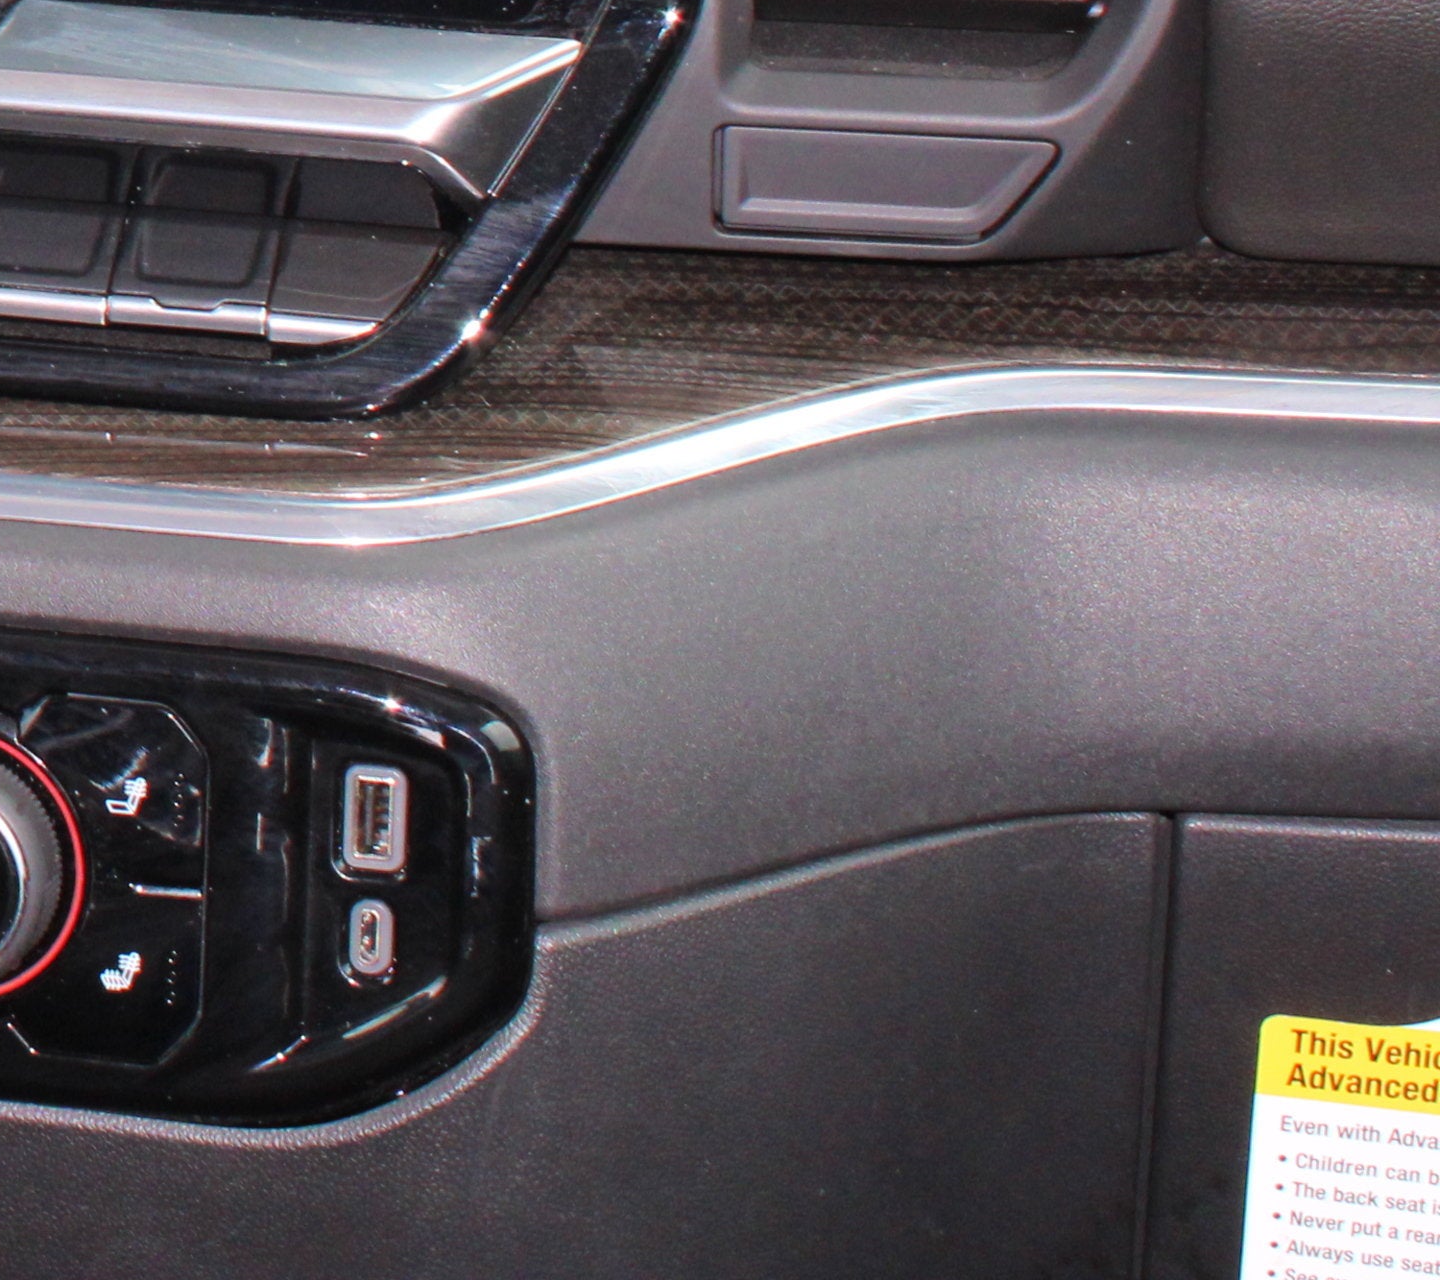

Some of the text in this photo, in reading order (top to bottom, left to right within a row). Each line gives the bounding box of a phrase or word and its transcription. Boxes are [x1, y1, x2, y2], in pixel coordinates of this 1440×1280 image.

[1291, 1028, 1354, 1059] This
[1286, 1062, 1439, 1103] Advanced
[1280, 1115, 1329, 1137] Even
[1337, 1123, 1381, 1142] with
[1295, 1152, 1378, 1177] Children
[1385, 1166, 1421, 1183] can
[1293, 1181, 1327, 1200] The
[1333, 1186, 1379, 1208] back
[1385, 1195, 1426, 1214] seat
[1290, 1209, 1345, 1231] Never
[1351, 1221, 1382, 1237] put
[1388, 1226, 1399, 1239] a
[1286, 1239, 1354, 1264] Always
[1361, 1251, 1394, 1268] use
